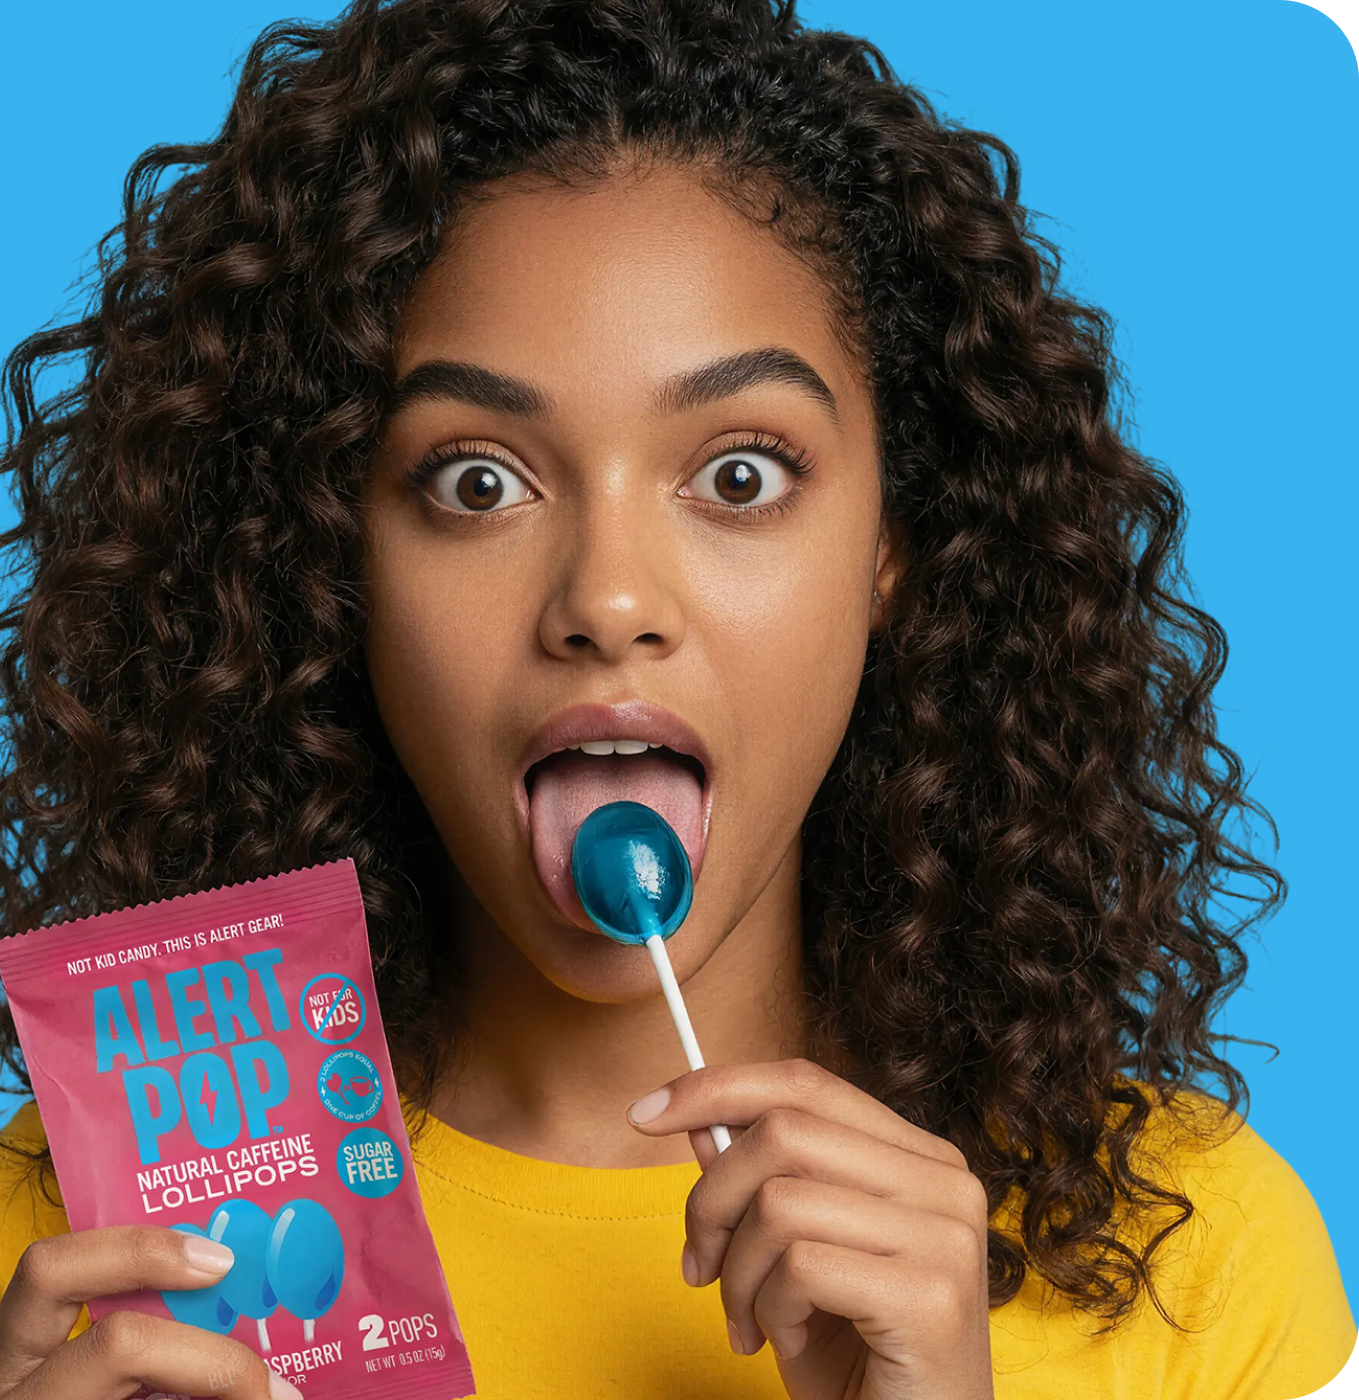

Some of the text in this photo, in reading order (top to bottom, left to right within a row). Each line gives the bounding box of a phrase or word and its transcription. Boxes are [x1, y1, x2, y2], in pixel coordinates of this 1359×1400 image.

[67, 913, 284, 976] NOT KID CANDY. THIS IS ALERT GEAR!
[92, 947, 291, 1074] ALERT
[308, 988, 353, 1007] NOT FOR
[312, 1001, 359, 1030] KIDS
[321, 1052, 354, 1076] LOLLIPOPS
[354, 1053, 374, 1074] EQUAL
[121, 1040, 290, 1165] POP
[324, 1099, 339, 1114] ONE
[338, 1111, 354, 1120] CUP
[136, 1133, 314, 1192] NATURAL CAFFEINE
[343, 1141, 393, 1162] SUGAR
[141, 1155, 319, 1214] LOLLIPOPS
[345, 1157, 398, 1184] FREE
[358, 1313, 438, 1352] 2 POPS
[365, 1344, 446, 1373] NET WT 0.5 OZ (15g)
